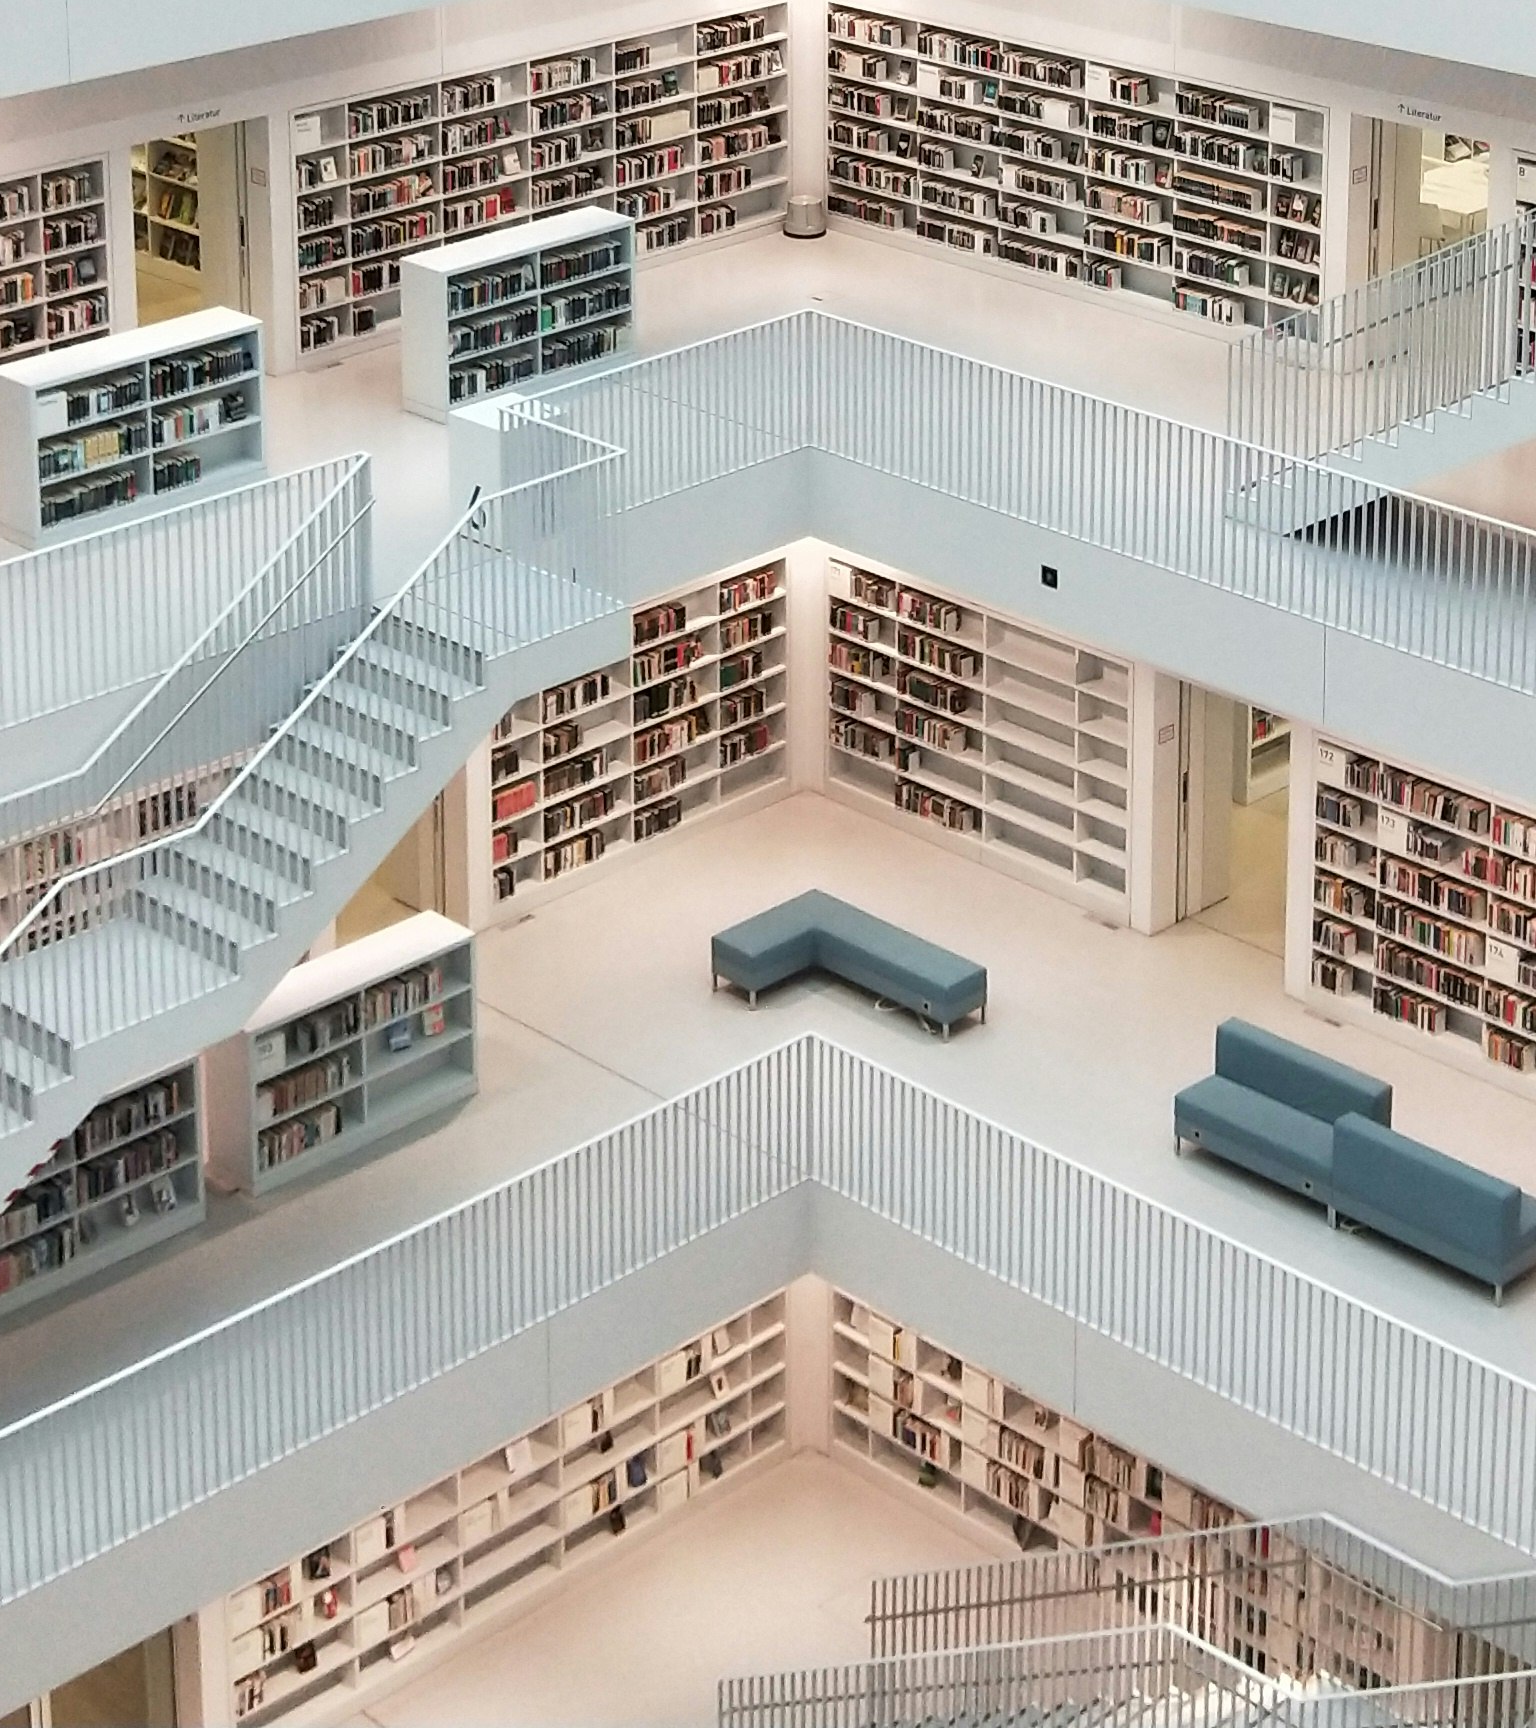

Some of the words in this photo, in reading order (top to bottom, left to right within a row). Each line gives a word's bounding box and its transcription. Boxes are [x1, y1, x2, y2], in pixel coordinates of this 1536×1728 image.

[186, 108, 221, 123] Literatur
[1406, 107, 1443, 121] Literatur
[1319, 748, 1334, 761] 172
